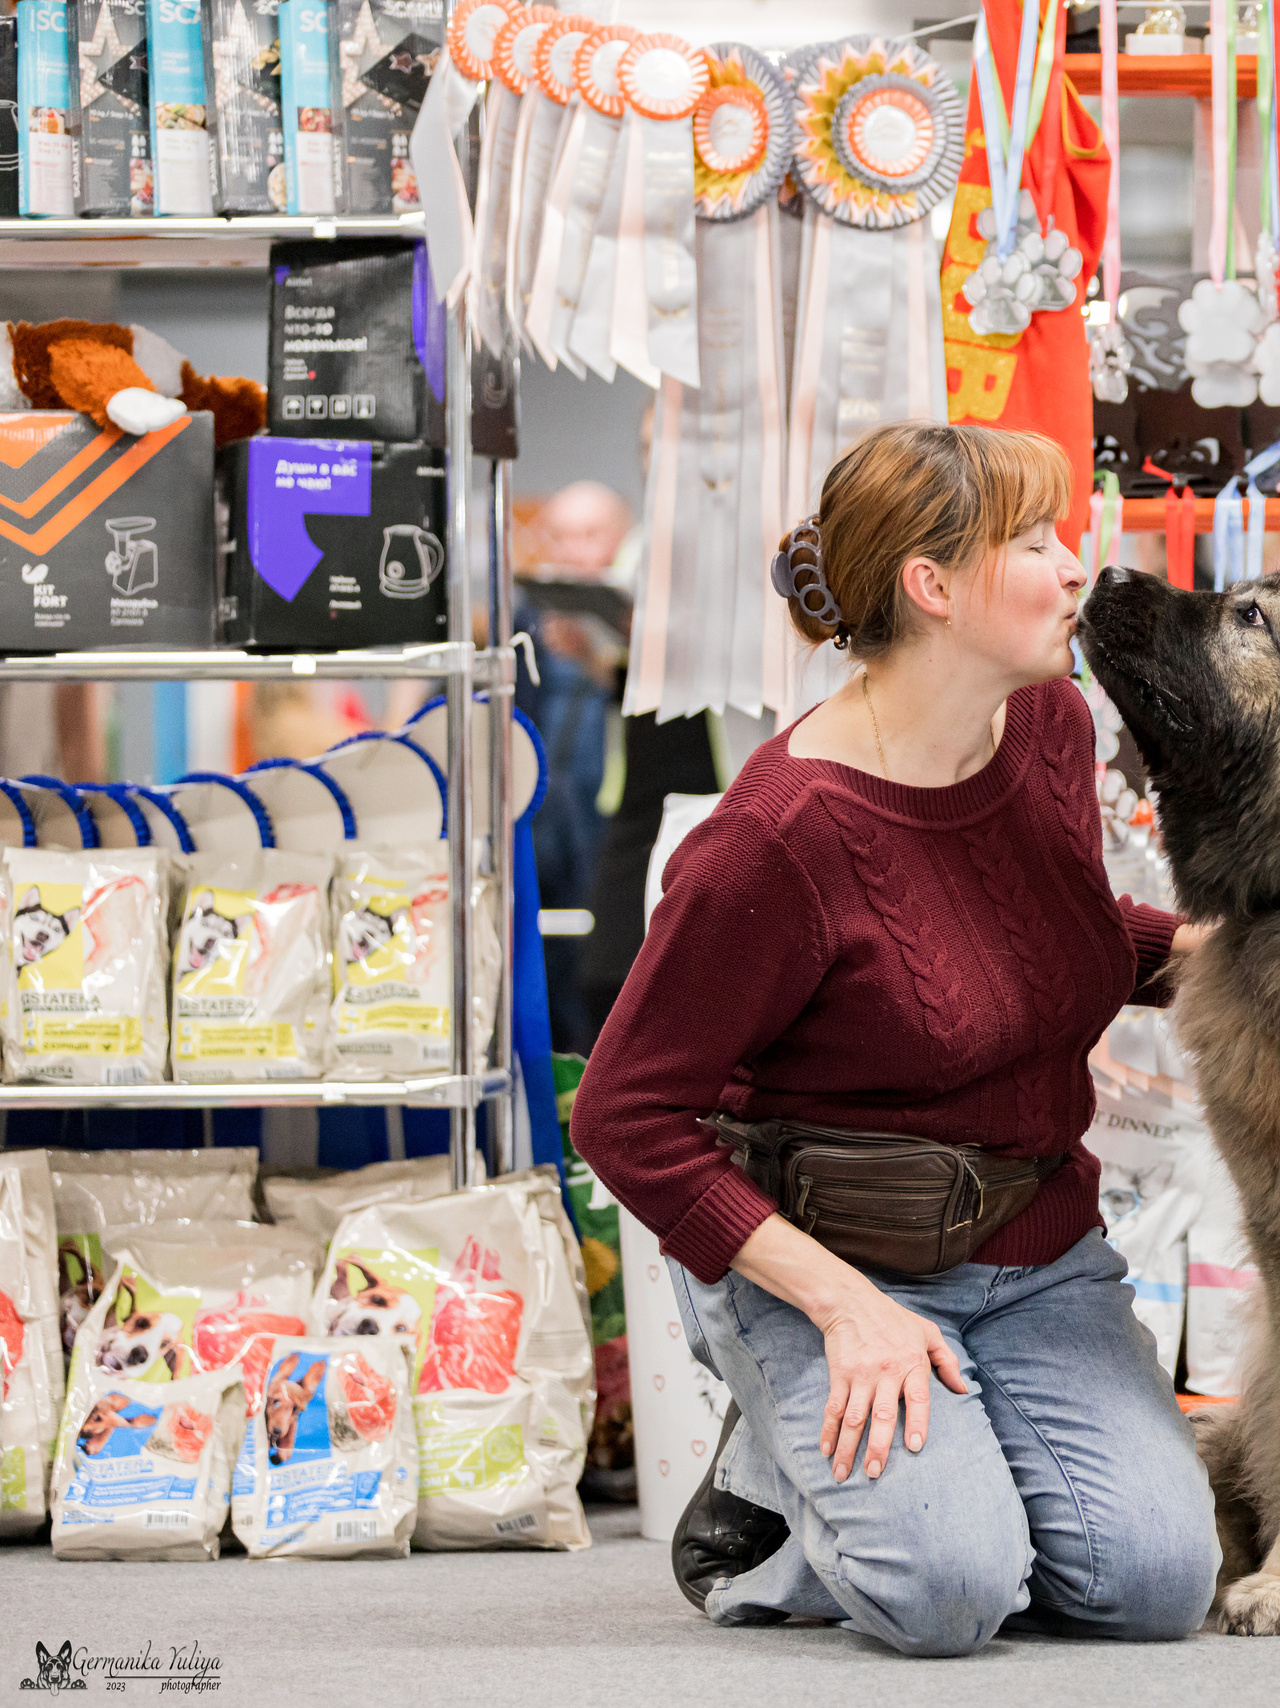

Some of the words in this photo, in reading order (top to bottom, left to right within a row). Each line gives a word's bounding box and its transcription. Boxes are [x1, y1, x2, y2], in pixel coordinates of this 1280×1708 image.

[37, 10, 67, 32] SC
[285, 304, 335, 320] Всегда
[33, 584, 55, 596] KIT
[33, 595, 68, 608] FORT
